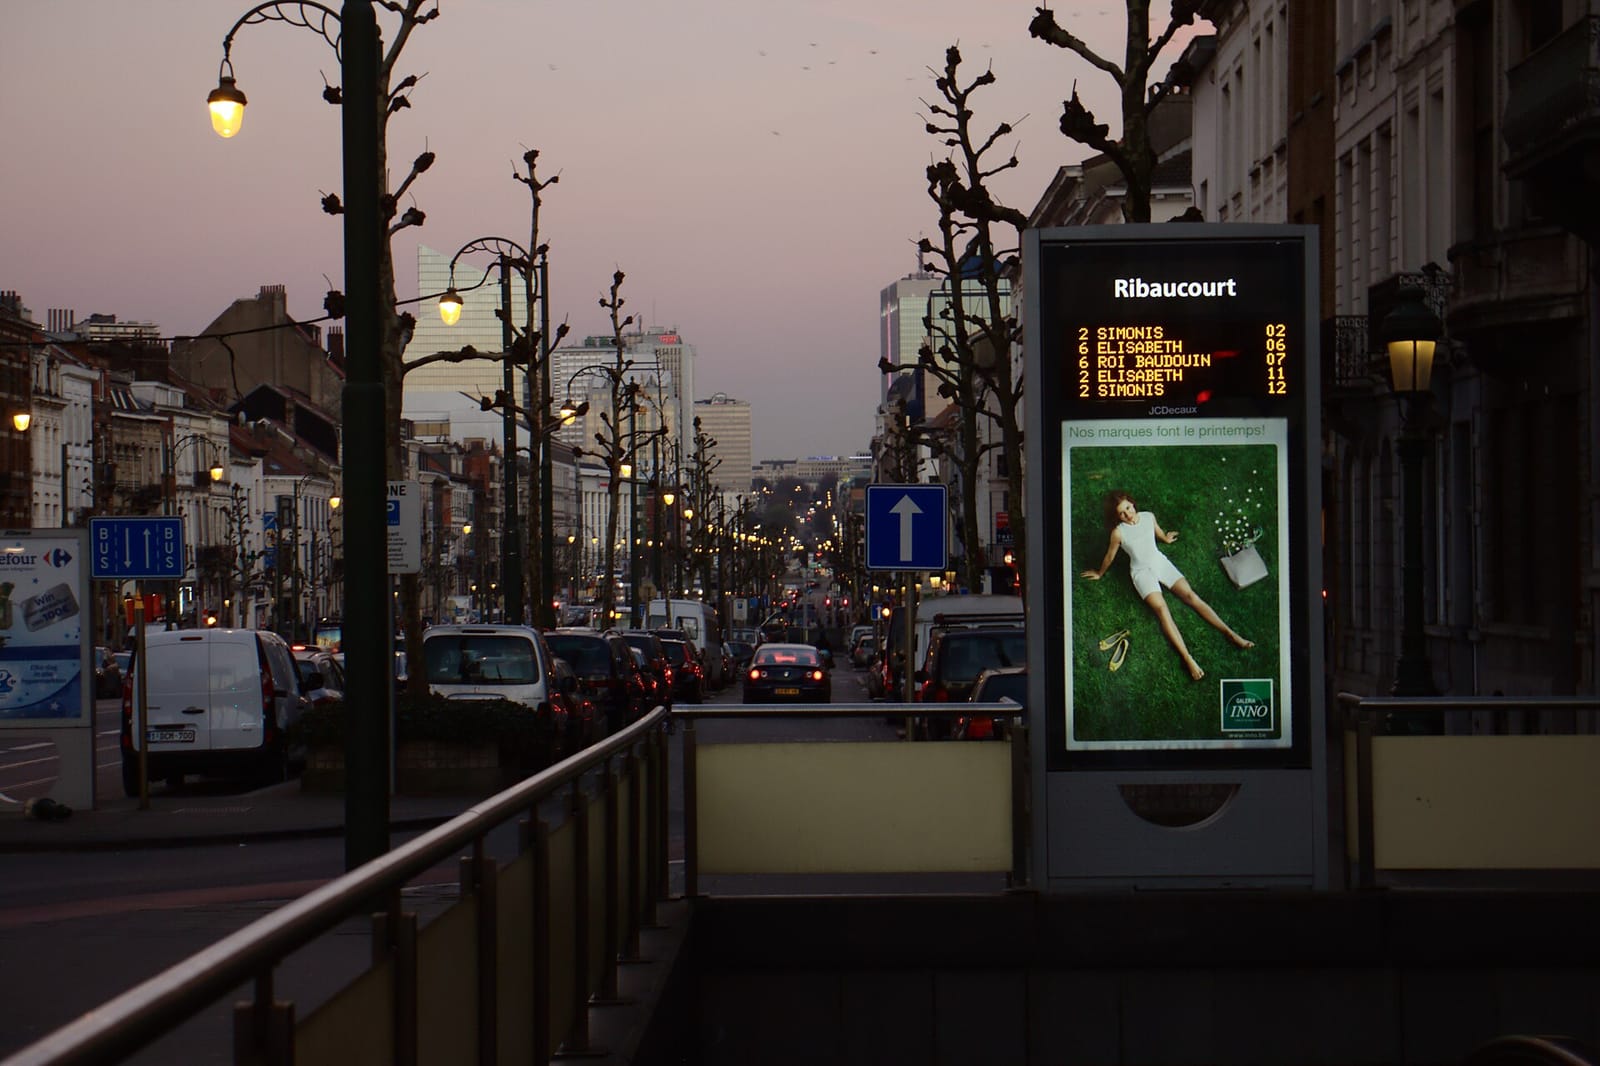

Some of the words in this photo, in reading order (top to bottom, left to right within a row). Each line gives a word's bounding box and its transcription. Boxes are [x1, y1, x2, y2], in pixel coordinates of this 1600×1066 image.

[1114, 277, 1237, 298] Ribaucourt
[1078, 327, 1089, 341] 2
[1097, 326, 1164, 340] SIMONIS
[1266, 324, 1286, 337] 02
[1079, 341, 1089, 355] 6
[1097, 340, 1183, 355] ELISABETH
[1266, 338, 1286, 351] 06
[1079, 356, 1089, 369] 6
[1097, 355, 1125, 369] ROI
[1135, 353, 1211, 368] BAUDOUIN
[1266, 352, 1286, 366] 07
[1079, 370, 1089, 383] 2
[1097, 369, 1183, 383] ELISABETH
[1267, 366, 1285, 380] 11
[1079, 384, 1090, 397] 2
[1098, 383, 1164, 397] SIMONIS
[1267, 381, 1286, 394] 12
[1148, 406, 1197, 415] JCDecaux
[1069, 426, 1094, 438] Nos
[1098, 427, 1153, 440] marques
[1156, 426, 1180, 437] font
[1184, 425, 1195, 437] le
[1198, 424, 1266, 439] printemps!
[1230, 705, 1268, 717] INNO
